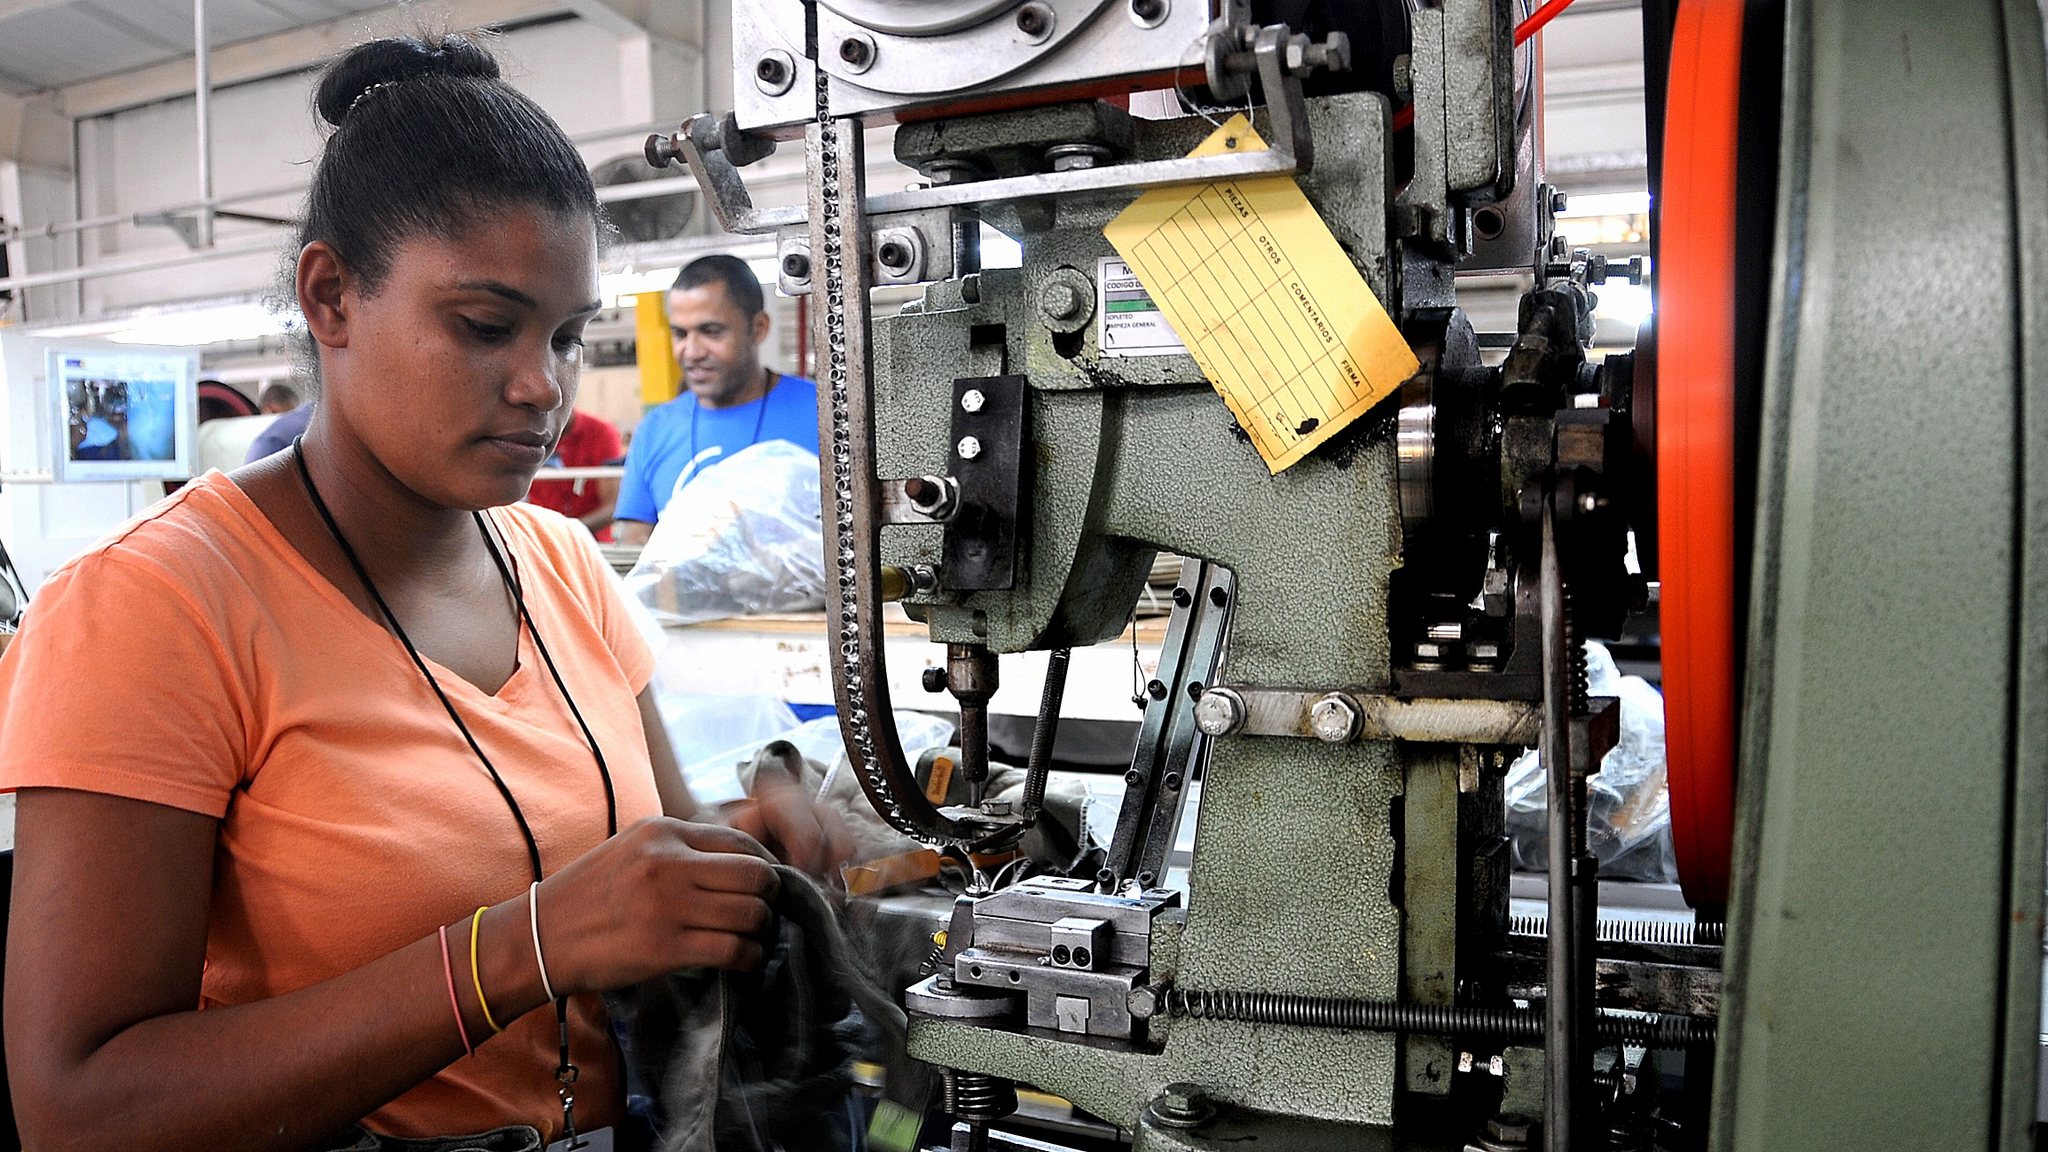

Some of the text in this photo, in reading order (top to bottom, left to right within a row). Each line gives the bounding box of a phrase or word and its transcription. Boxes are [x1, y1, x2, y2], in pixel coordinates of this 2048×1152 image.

[1107, 281, 1134, 289] CODIGO
[1225, 188, 1360, 388] PIEZAS OTROS COMENTARIOS FIRMA
